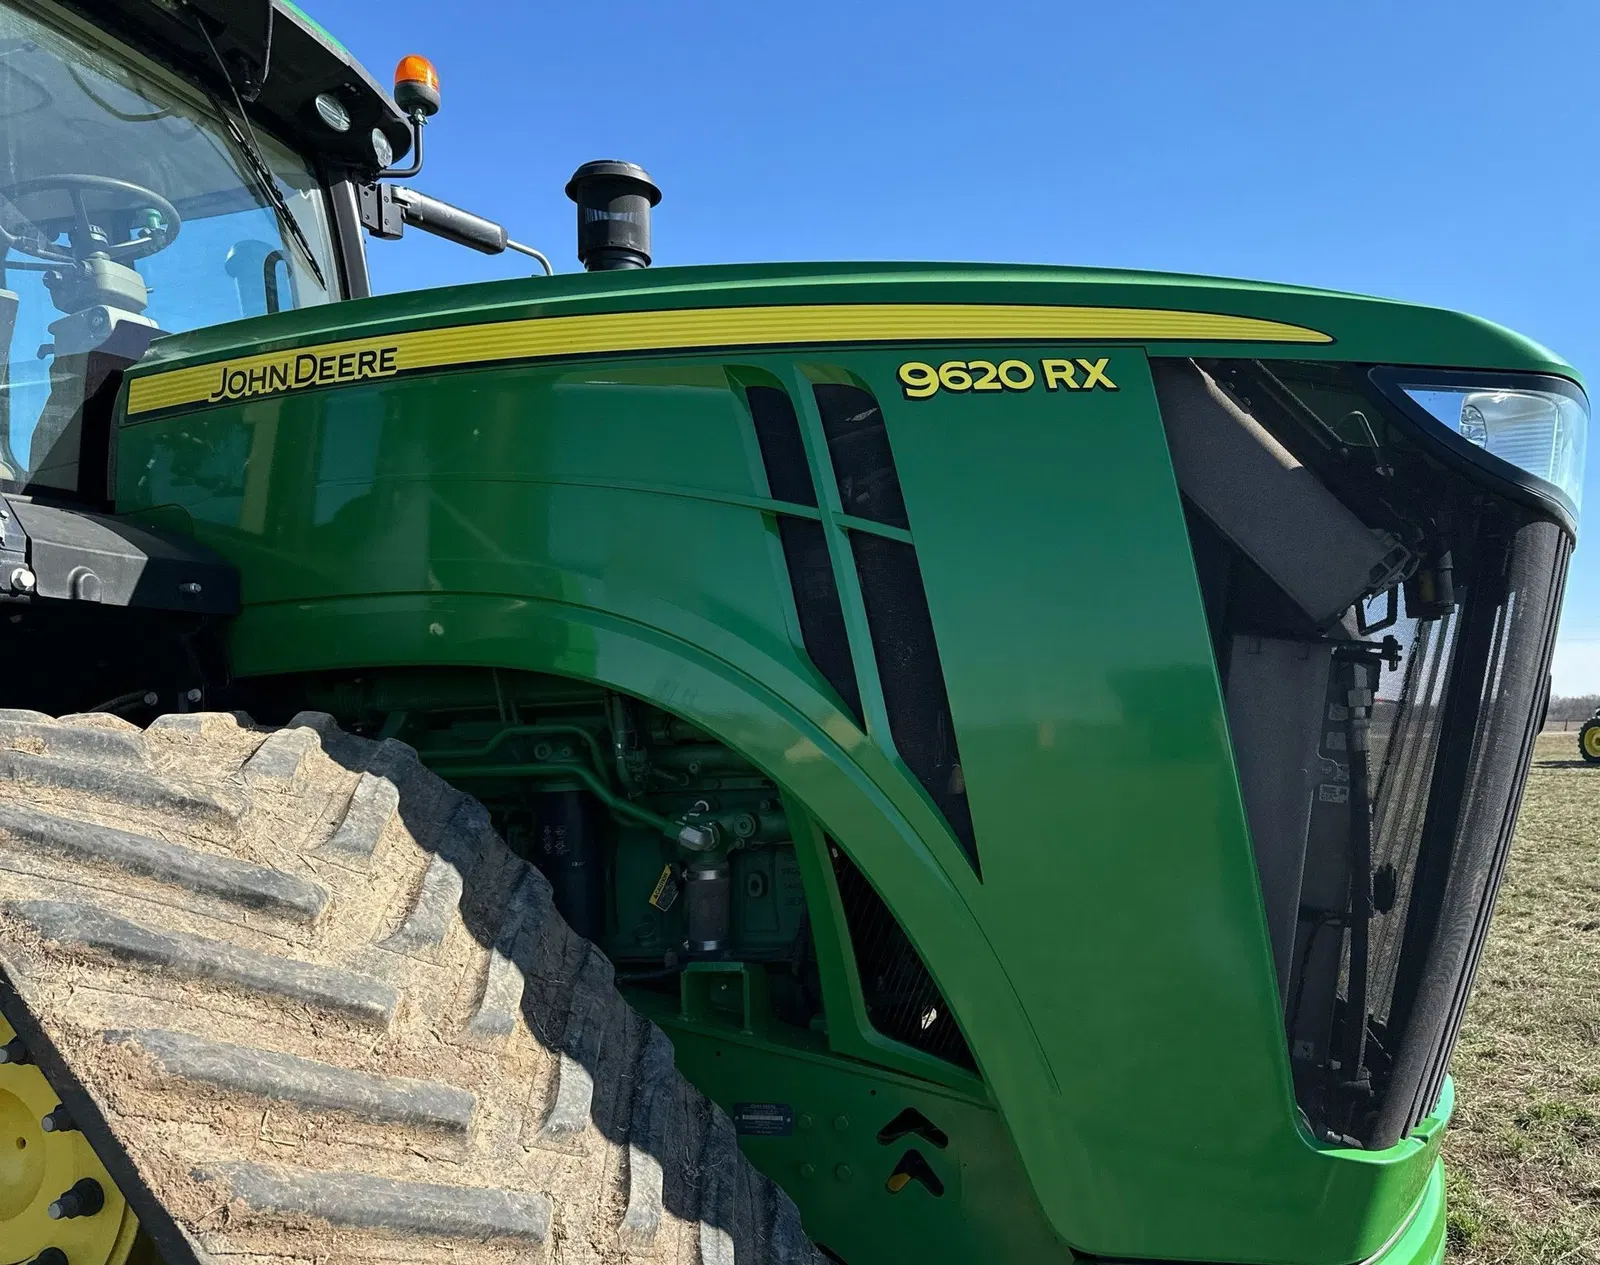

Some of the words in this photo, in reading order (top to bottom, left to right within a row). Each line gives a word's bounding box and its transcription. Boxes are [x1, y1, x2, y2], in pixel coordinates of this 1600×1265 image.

[210, 363, 288, 399] JOHN
[294, 347, 398, 385] DEERE
[897, 359, 1036, 400] 9620
[1041, 358, 1119, 392] RX
[655, 872, 668, 894] CAUTION
